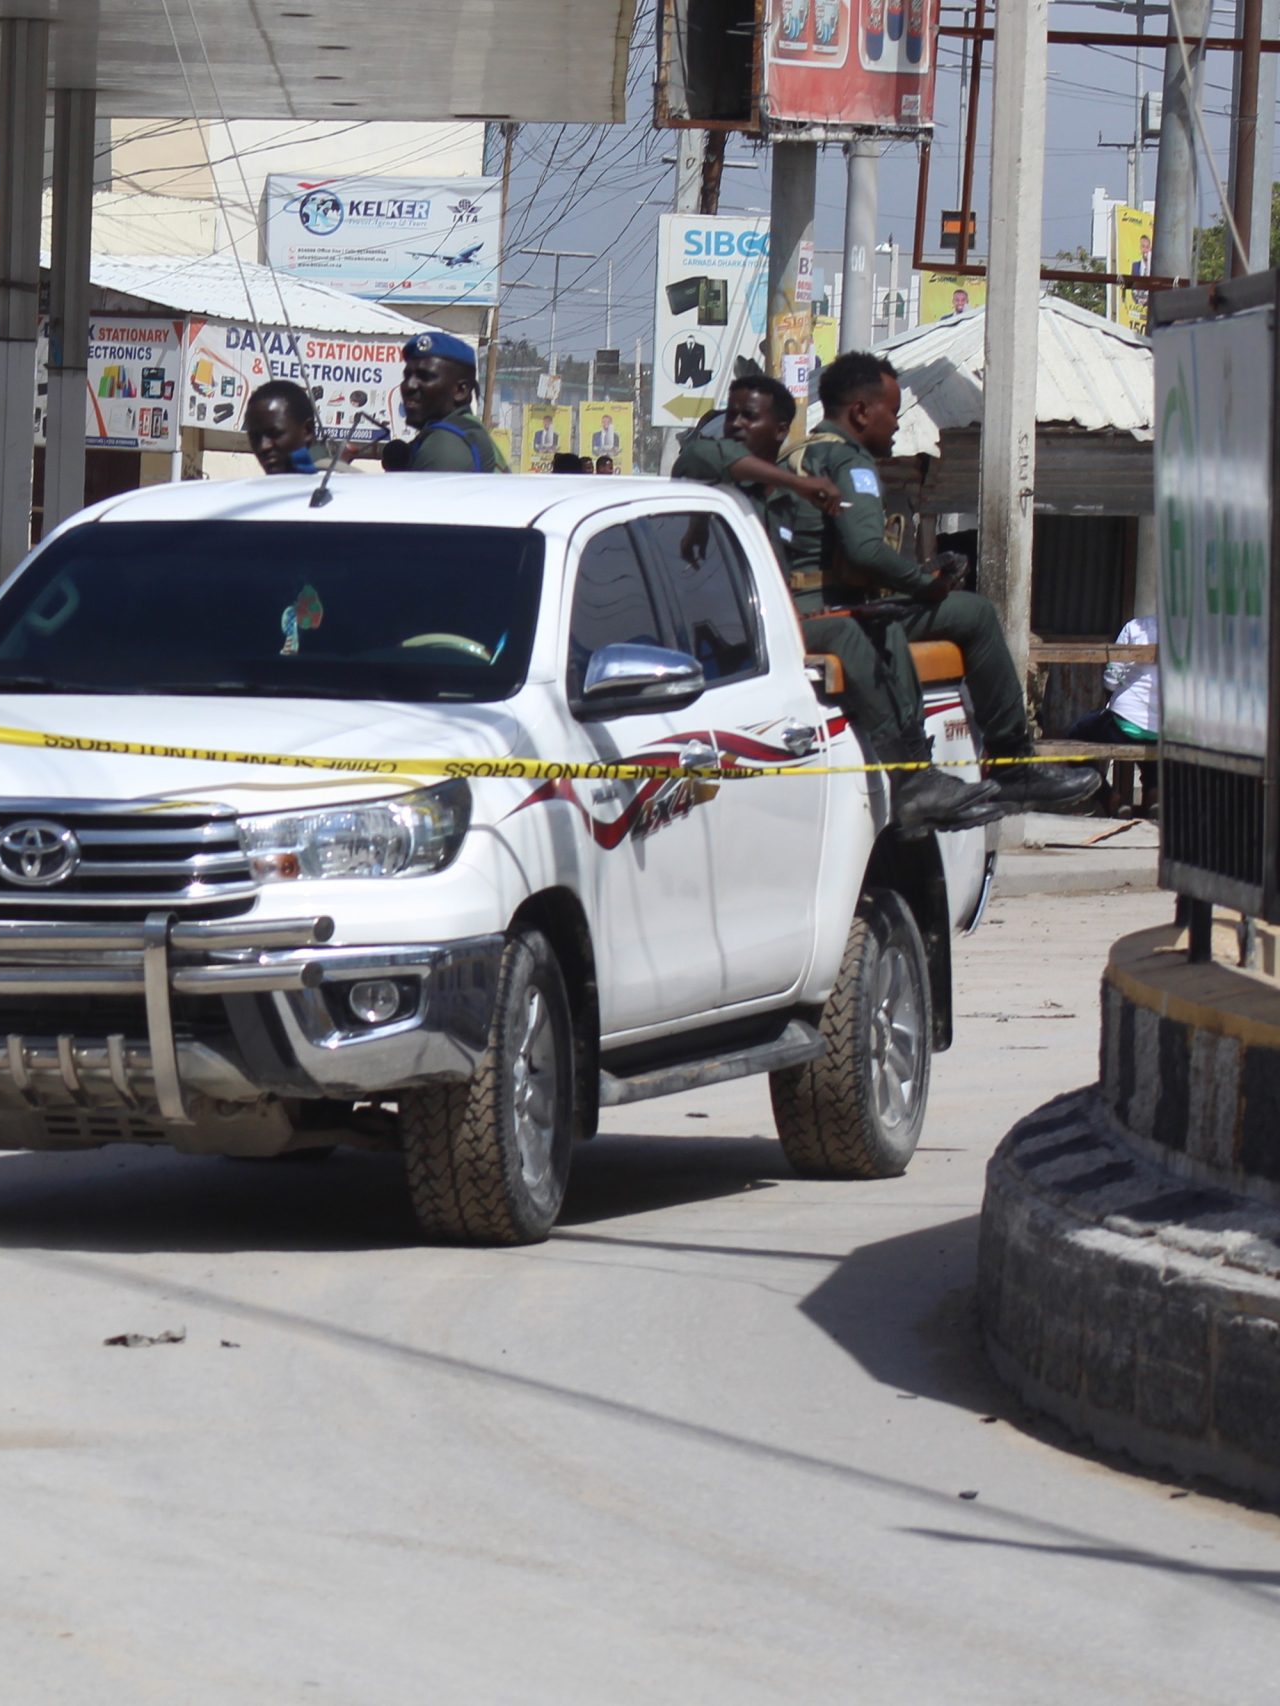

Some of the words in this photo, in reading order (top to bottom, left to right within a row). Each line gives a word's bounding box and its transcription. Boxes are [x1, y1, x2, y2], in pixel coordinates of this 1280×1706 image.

[348, 200, 430, 219] KELKER
[98, 326, 170, 343] STATIONARY
[225, 326, 300, 357] DAYAX
[251, 357, 264, 375] &
[270, 360, 383, 384] ELECTRONICS
[444, 762, 527, 778] CROSS
[533, 764, 581, 779] NOT
